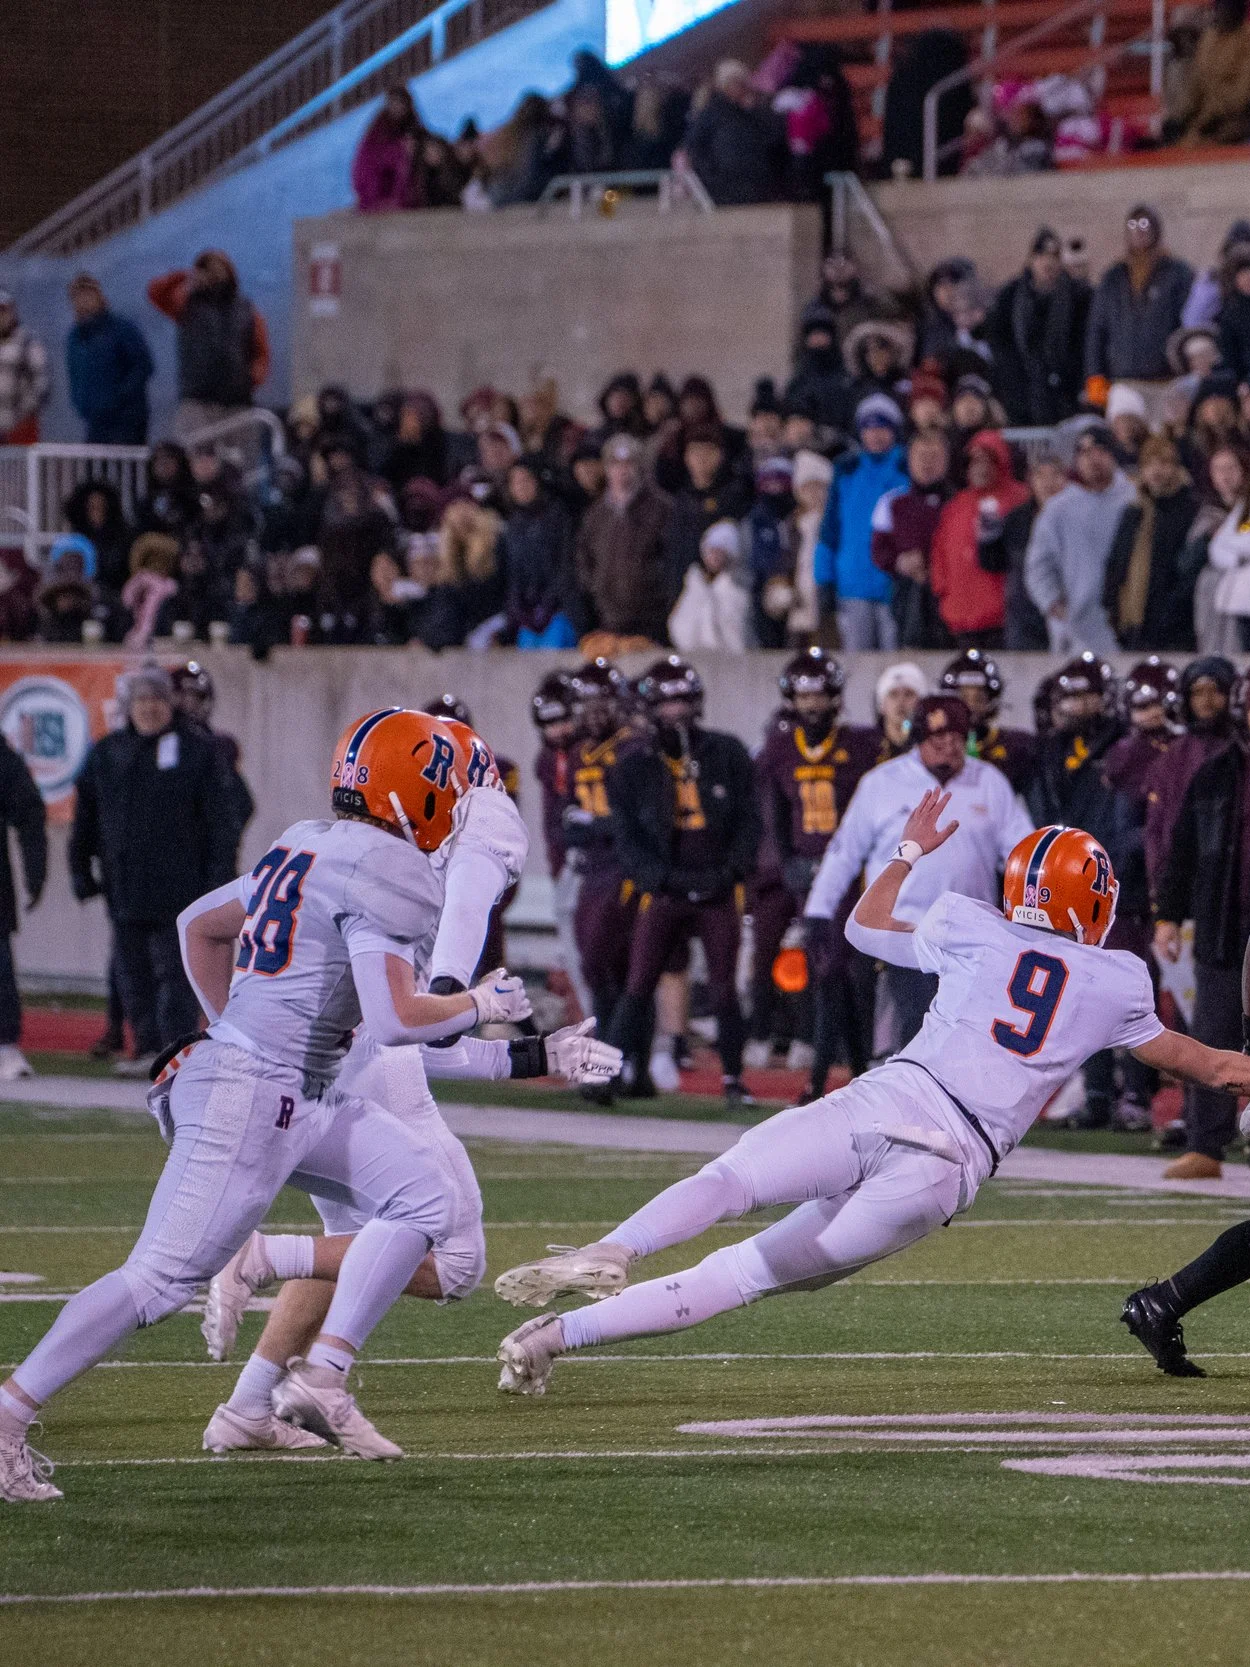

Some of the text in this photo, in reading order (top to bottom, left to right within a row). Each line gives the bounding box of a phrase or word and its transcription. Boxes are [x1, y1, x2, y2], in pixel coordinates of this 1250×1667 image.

[421, 731, 455, 791] R
[467, 739, 491, 788] R
[1039, 887, 1051, 904] 9
[1090, 849, 1110, 897] R
[234, 845, 317, 977] 28
[1015, 909, 1045, 922] VICIS
[990, 949, 1070, 1058] 9
[275, 1094, 295, 1131] R
